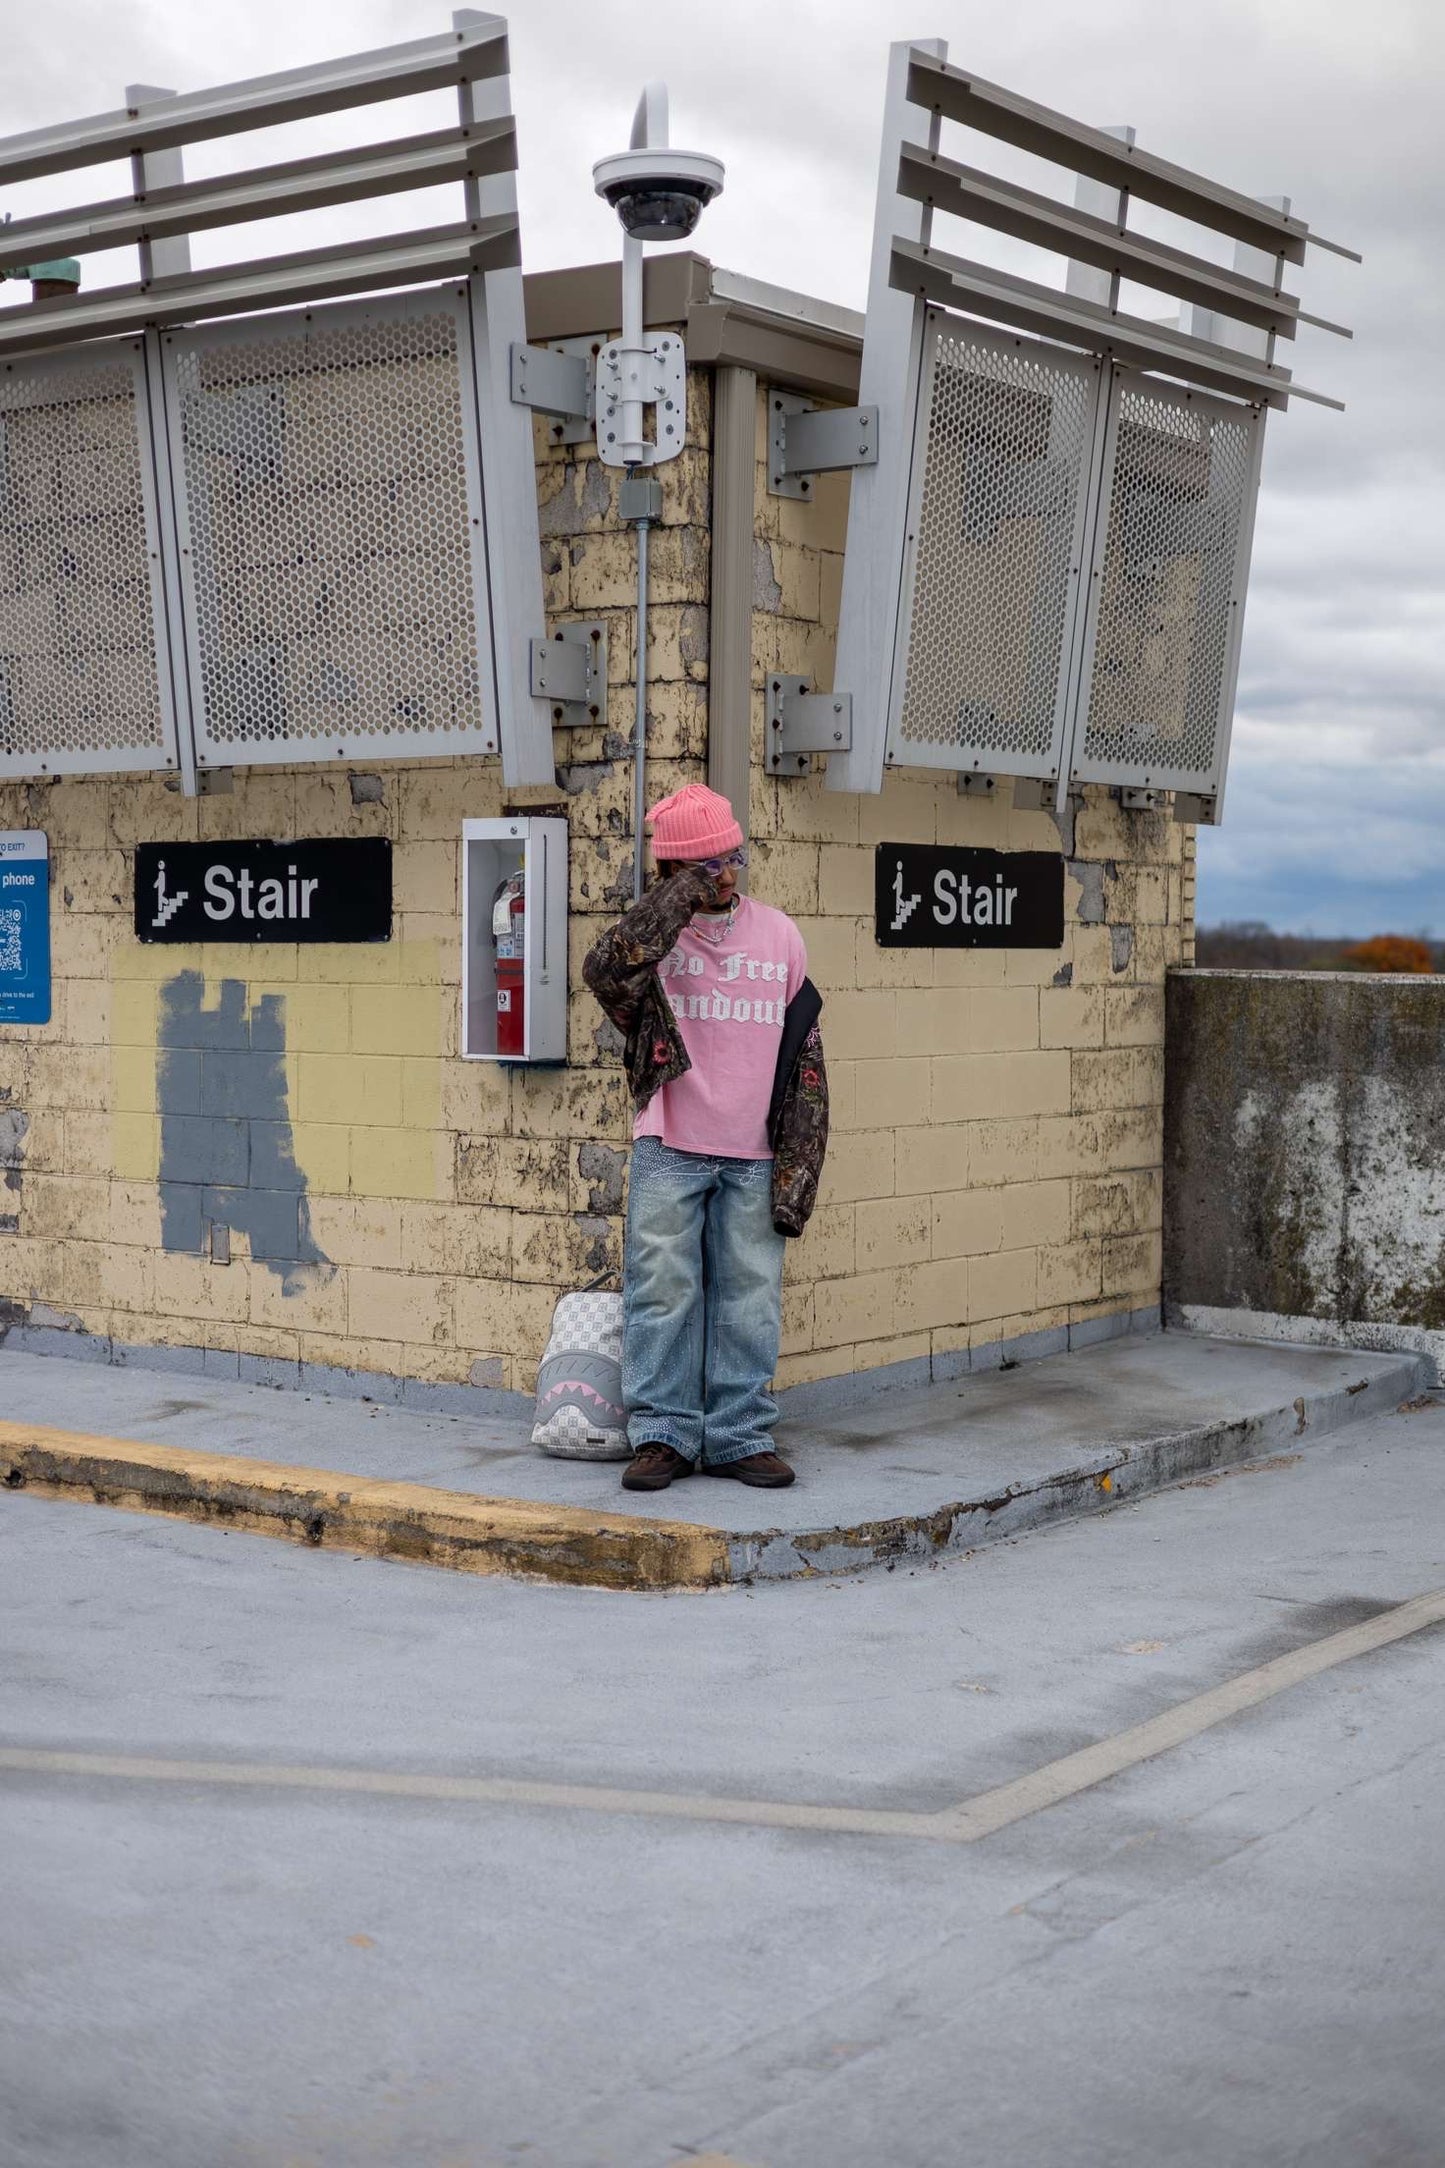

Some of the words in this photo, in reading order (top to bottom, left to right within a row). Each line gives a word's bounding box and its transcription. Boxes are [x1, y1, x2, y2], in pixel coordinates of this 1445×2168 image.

[2, 872, 35, 888] phone
[203, 865, 319, 920] Stair
[932, 869, 1018, 925] Stair
[717, 952, 788, 983] Free
